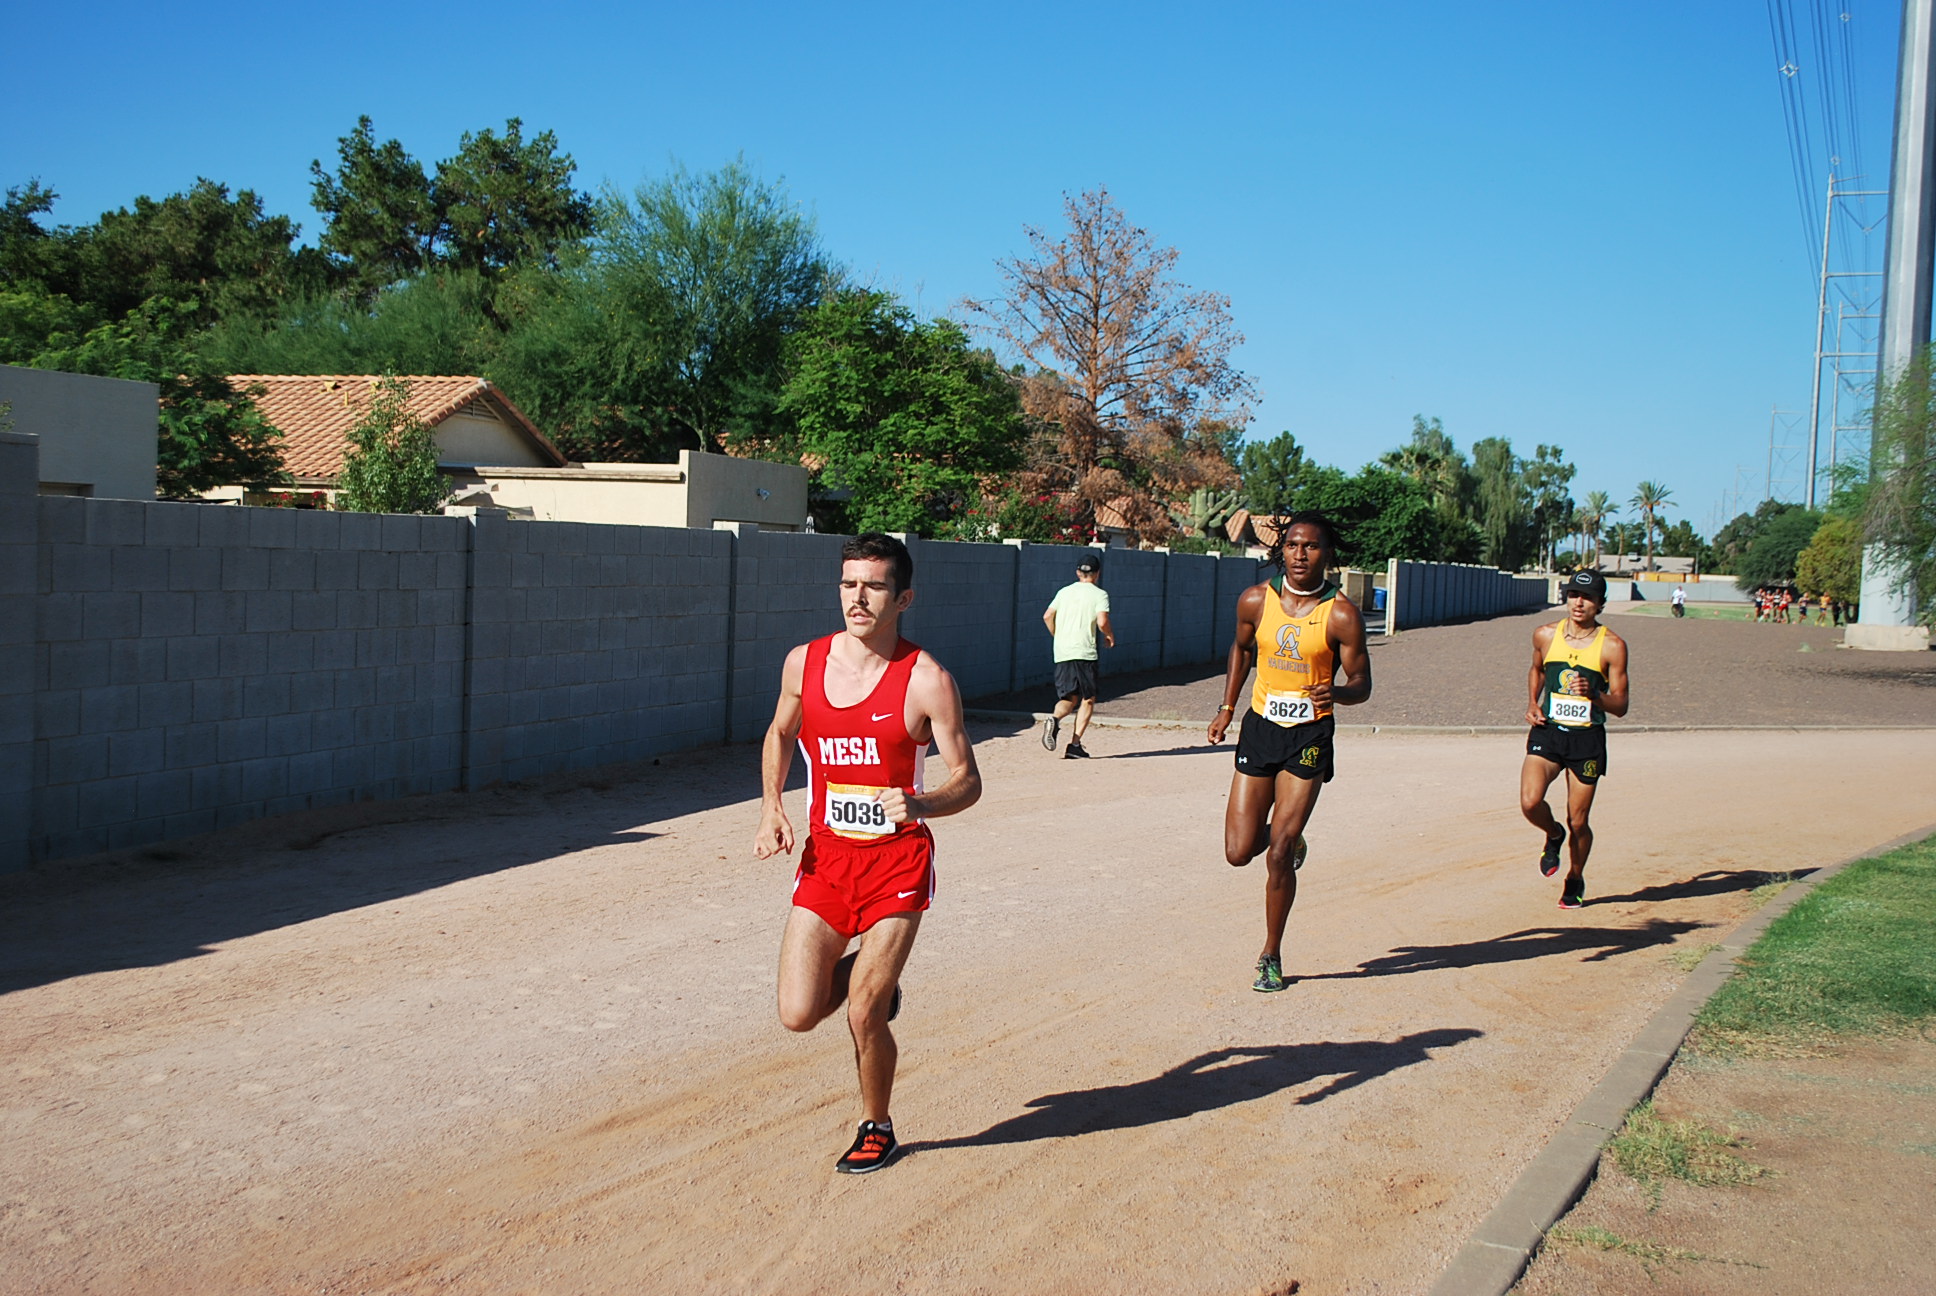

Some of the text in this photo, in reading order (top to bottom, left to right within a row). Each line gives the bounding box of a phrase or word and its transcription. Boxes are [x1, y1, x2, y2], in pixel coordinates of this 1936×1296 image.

[1269, 701, 1309, 718] 3622
[1556, 703, 1587, 718] 3862
[818, 737, 881, 765] MESA
[831, 800, 886, 826] 5039
